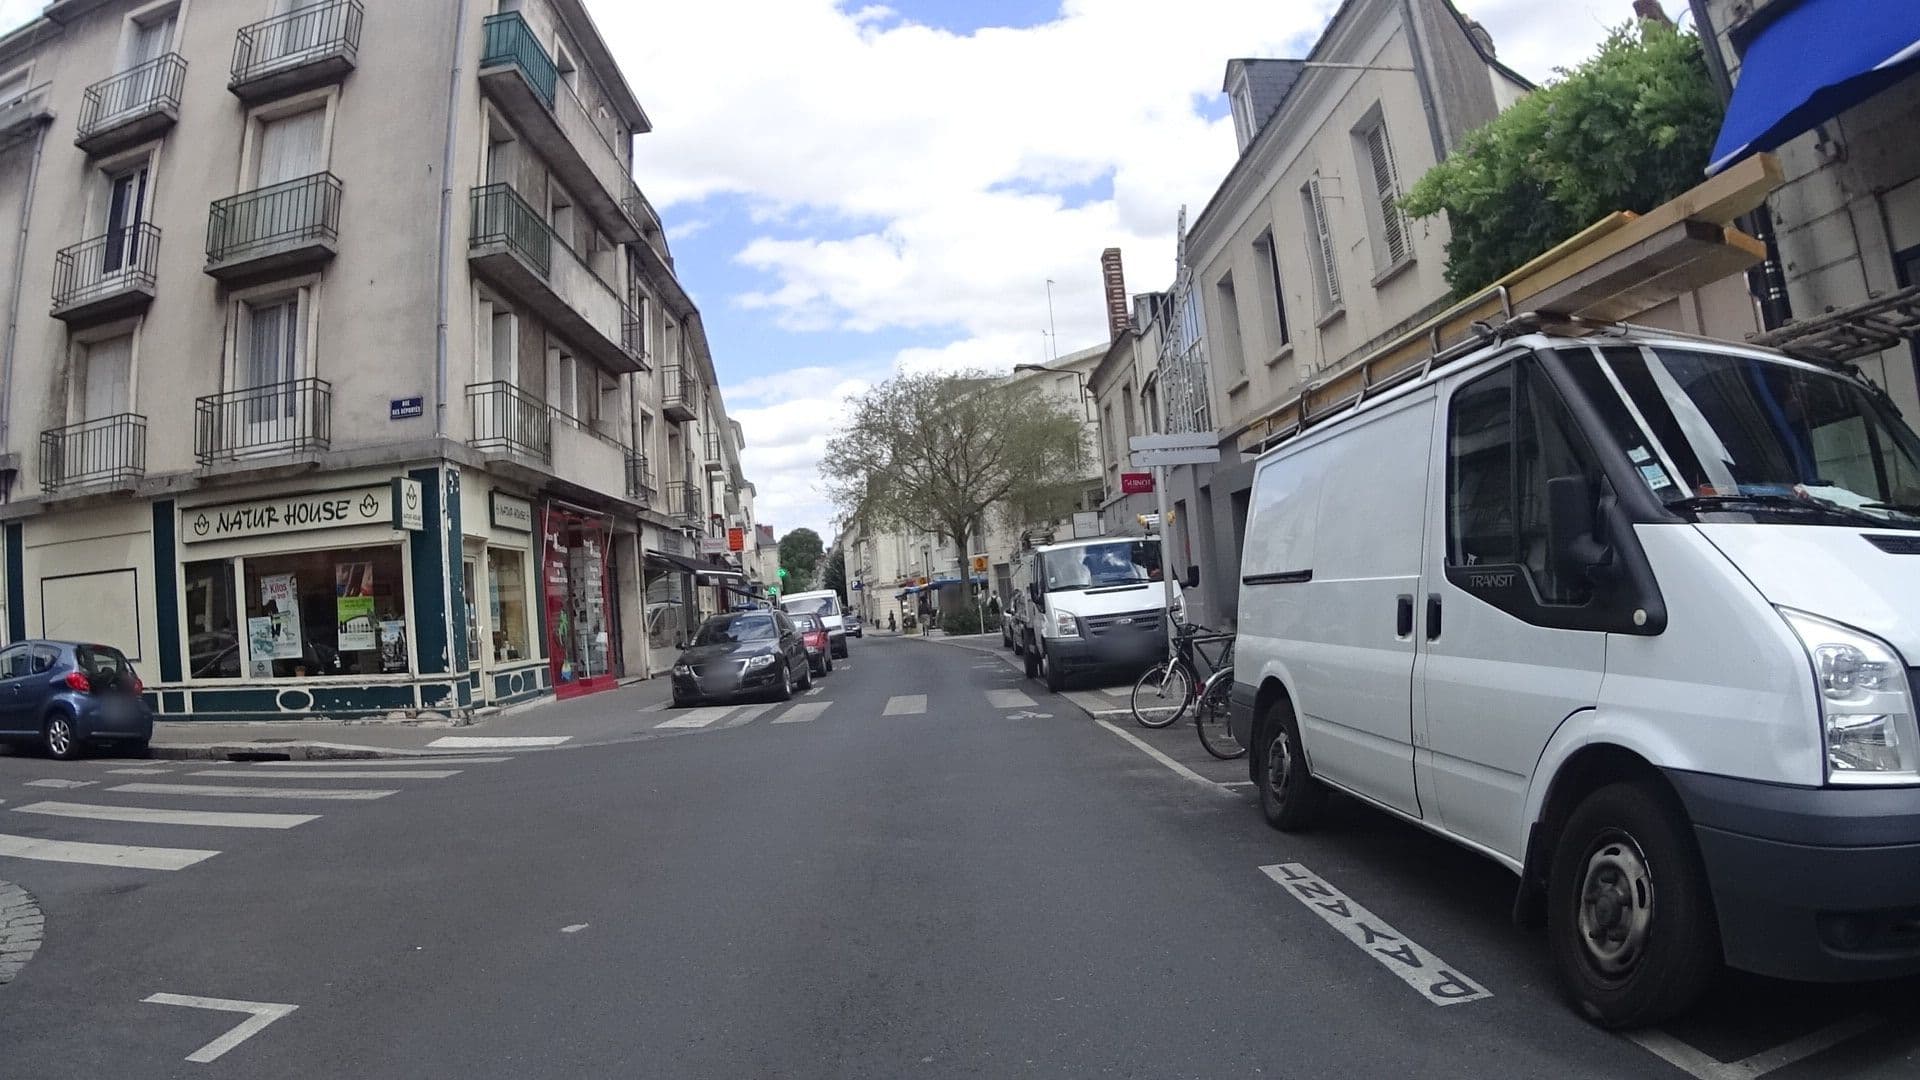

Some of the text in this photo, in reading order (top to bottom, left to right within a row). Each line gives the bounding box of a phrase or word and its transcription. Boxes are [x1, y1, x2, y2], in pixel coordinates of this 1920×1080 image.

[216, 499, 351, 534] NATUR HOUSE
[269, 583, 287, 594] Kilos
[1470, 574, 1515, 587] TRANSIT
[1279, 866, 1479, 998] PAYANT
